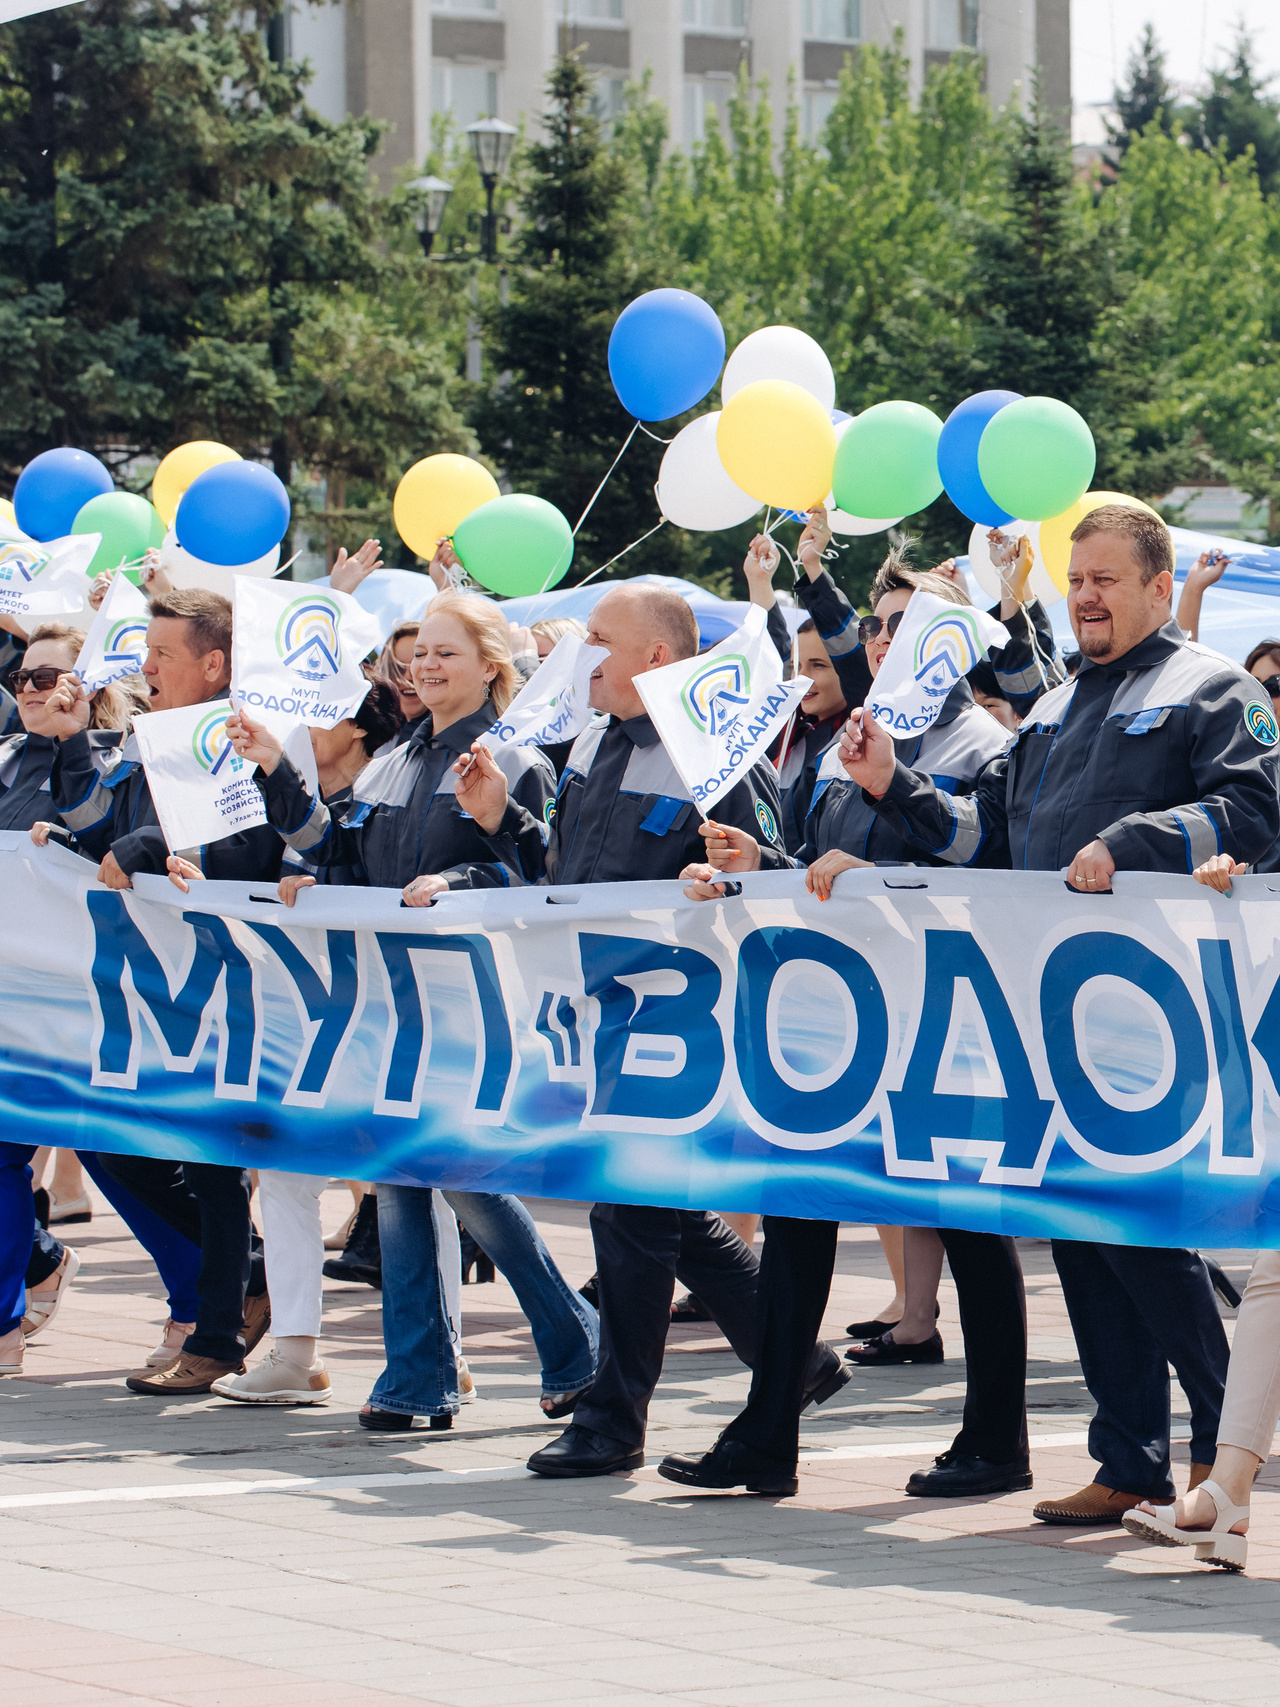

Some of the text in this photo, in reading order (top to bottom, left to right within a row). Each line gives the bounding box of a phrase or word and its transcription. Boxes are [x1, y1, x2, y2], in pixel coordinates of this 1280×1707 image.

[0, 589, 23, 599] ИТЕТ
[291, 687, 320, 700] МУП
[725, 721, 744, 752] МУП
[221, 779, 256, 795] КОМИТЕ
[214, 786, 260, 808] ГОРОДСКО
[221, 795, 265, 816] ХОЗЯЙСТВ
[235, 809, 267, 823] Улан-Уд
[87, 890, 507, 1113] МУП
